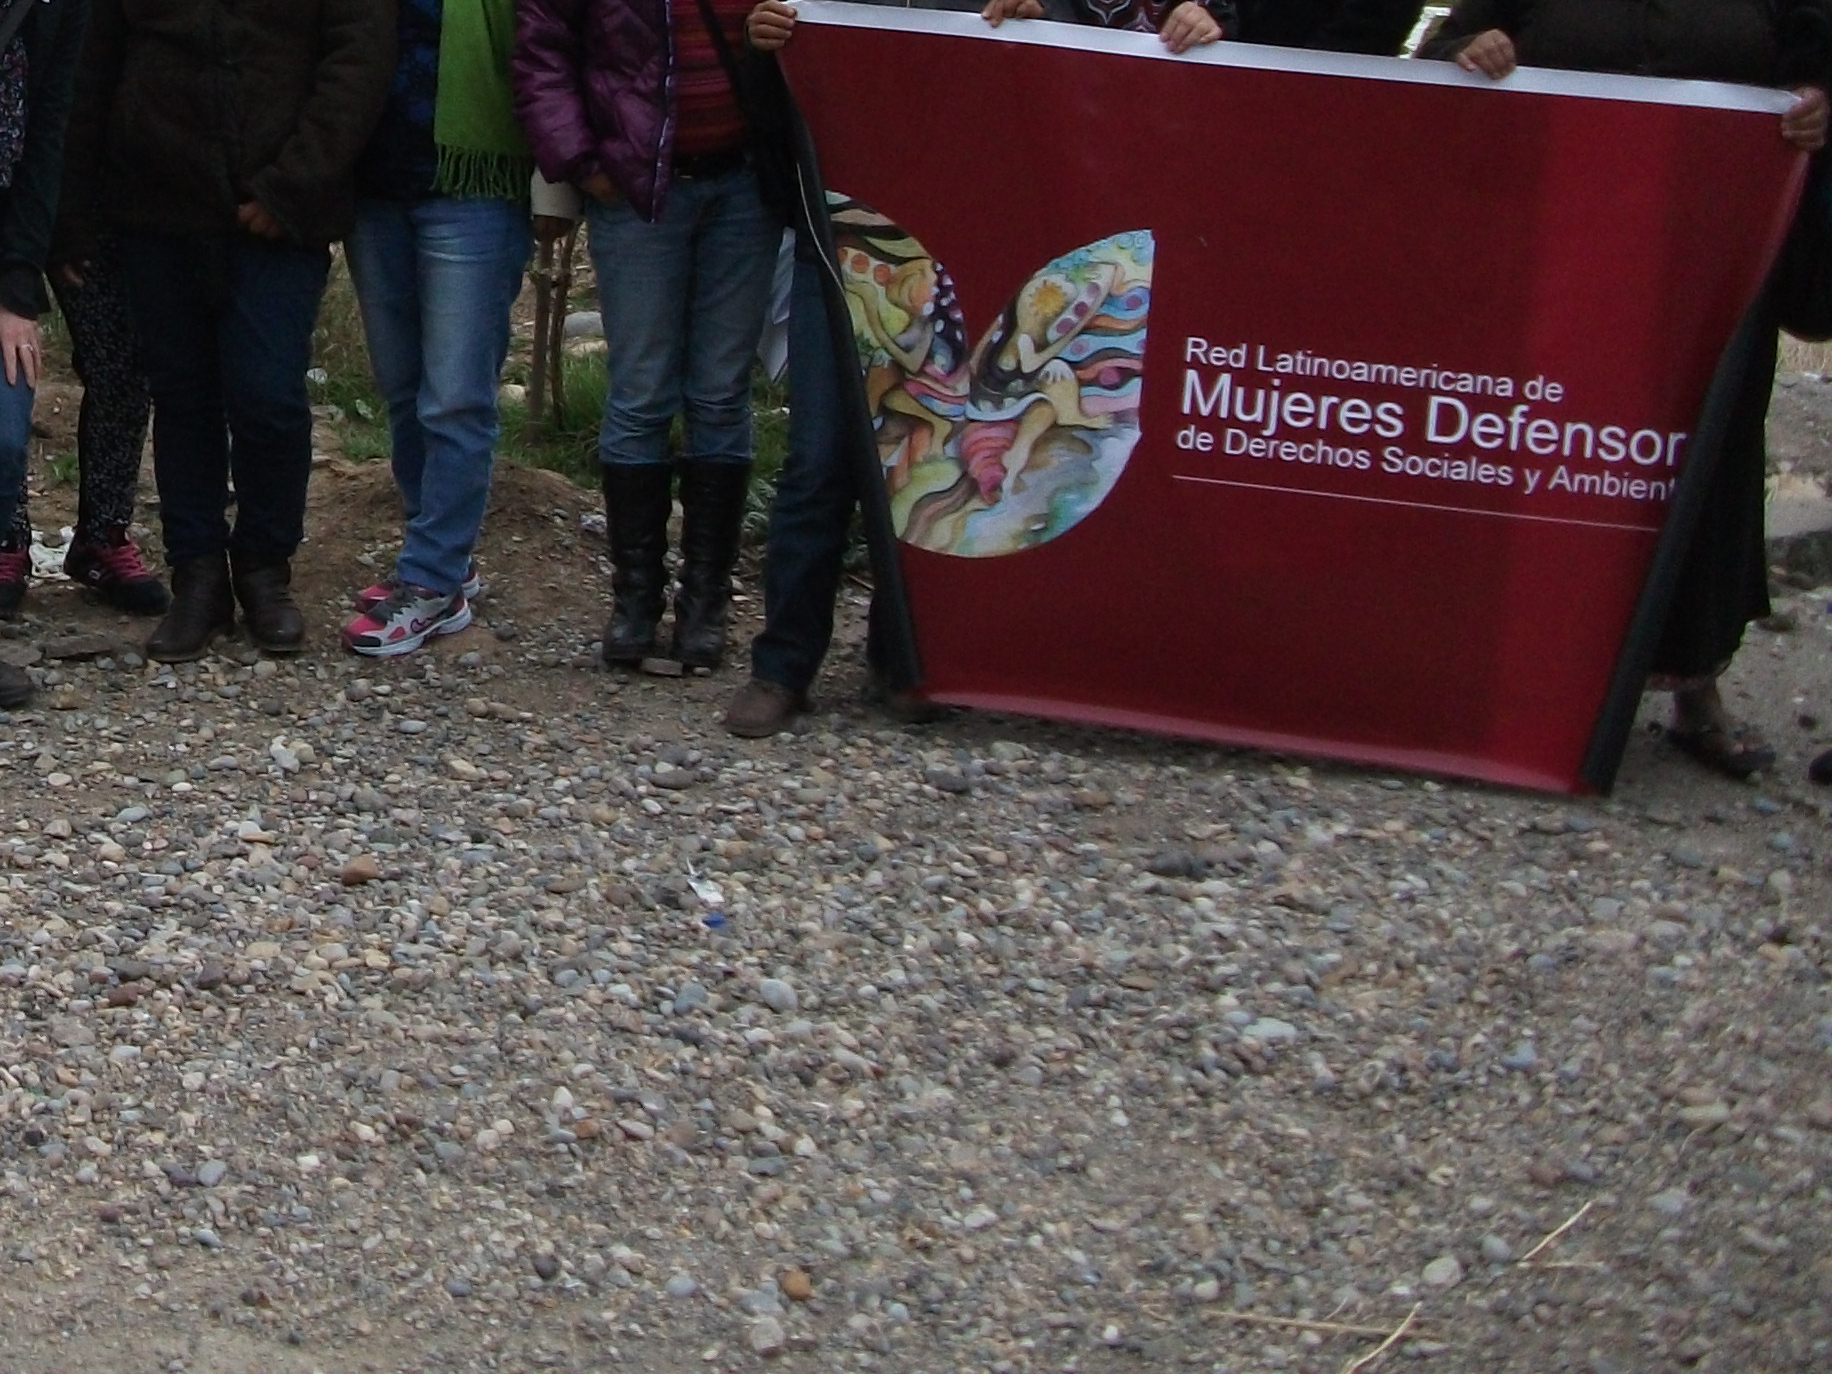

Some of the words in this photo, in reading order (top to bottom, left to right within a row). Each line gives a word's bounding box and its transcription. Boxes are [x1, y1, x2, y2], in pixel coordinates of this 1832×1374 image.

[1185, 336, 1247, 369] Red
[1257, 344, 1513, 397] Latinoamericana
[1524, 375, 1564, 403] de
[1180, 369, 1405, 438] Mujeres
[1426, 395, 1687, 466] Defensor
[1176, 425, 1214, 451] de
[1224, 428, 1372, 470] Derechos
[1381, 446, 1514, 486] Sociales
[1524, 468, 1541, 495] y
